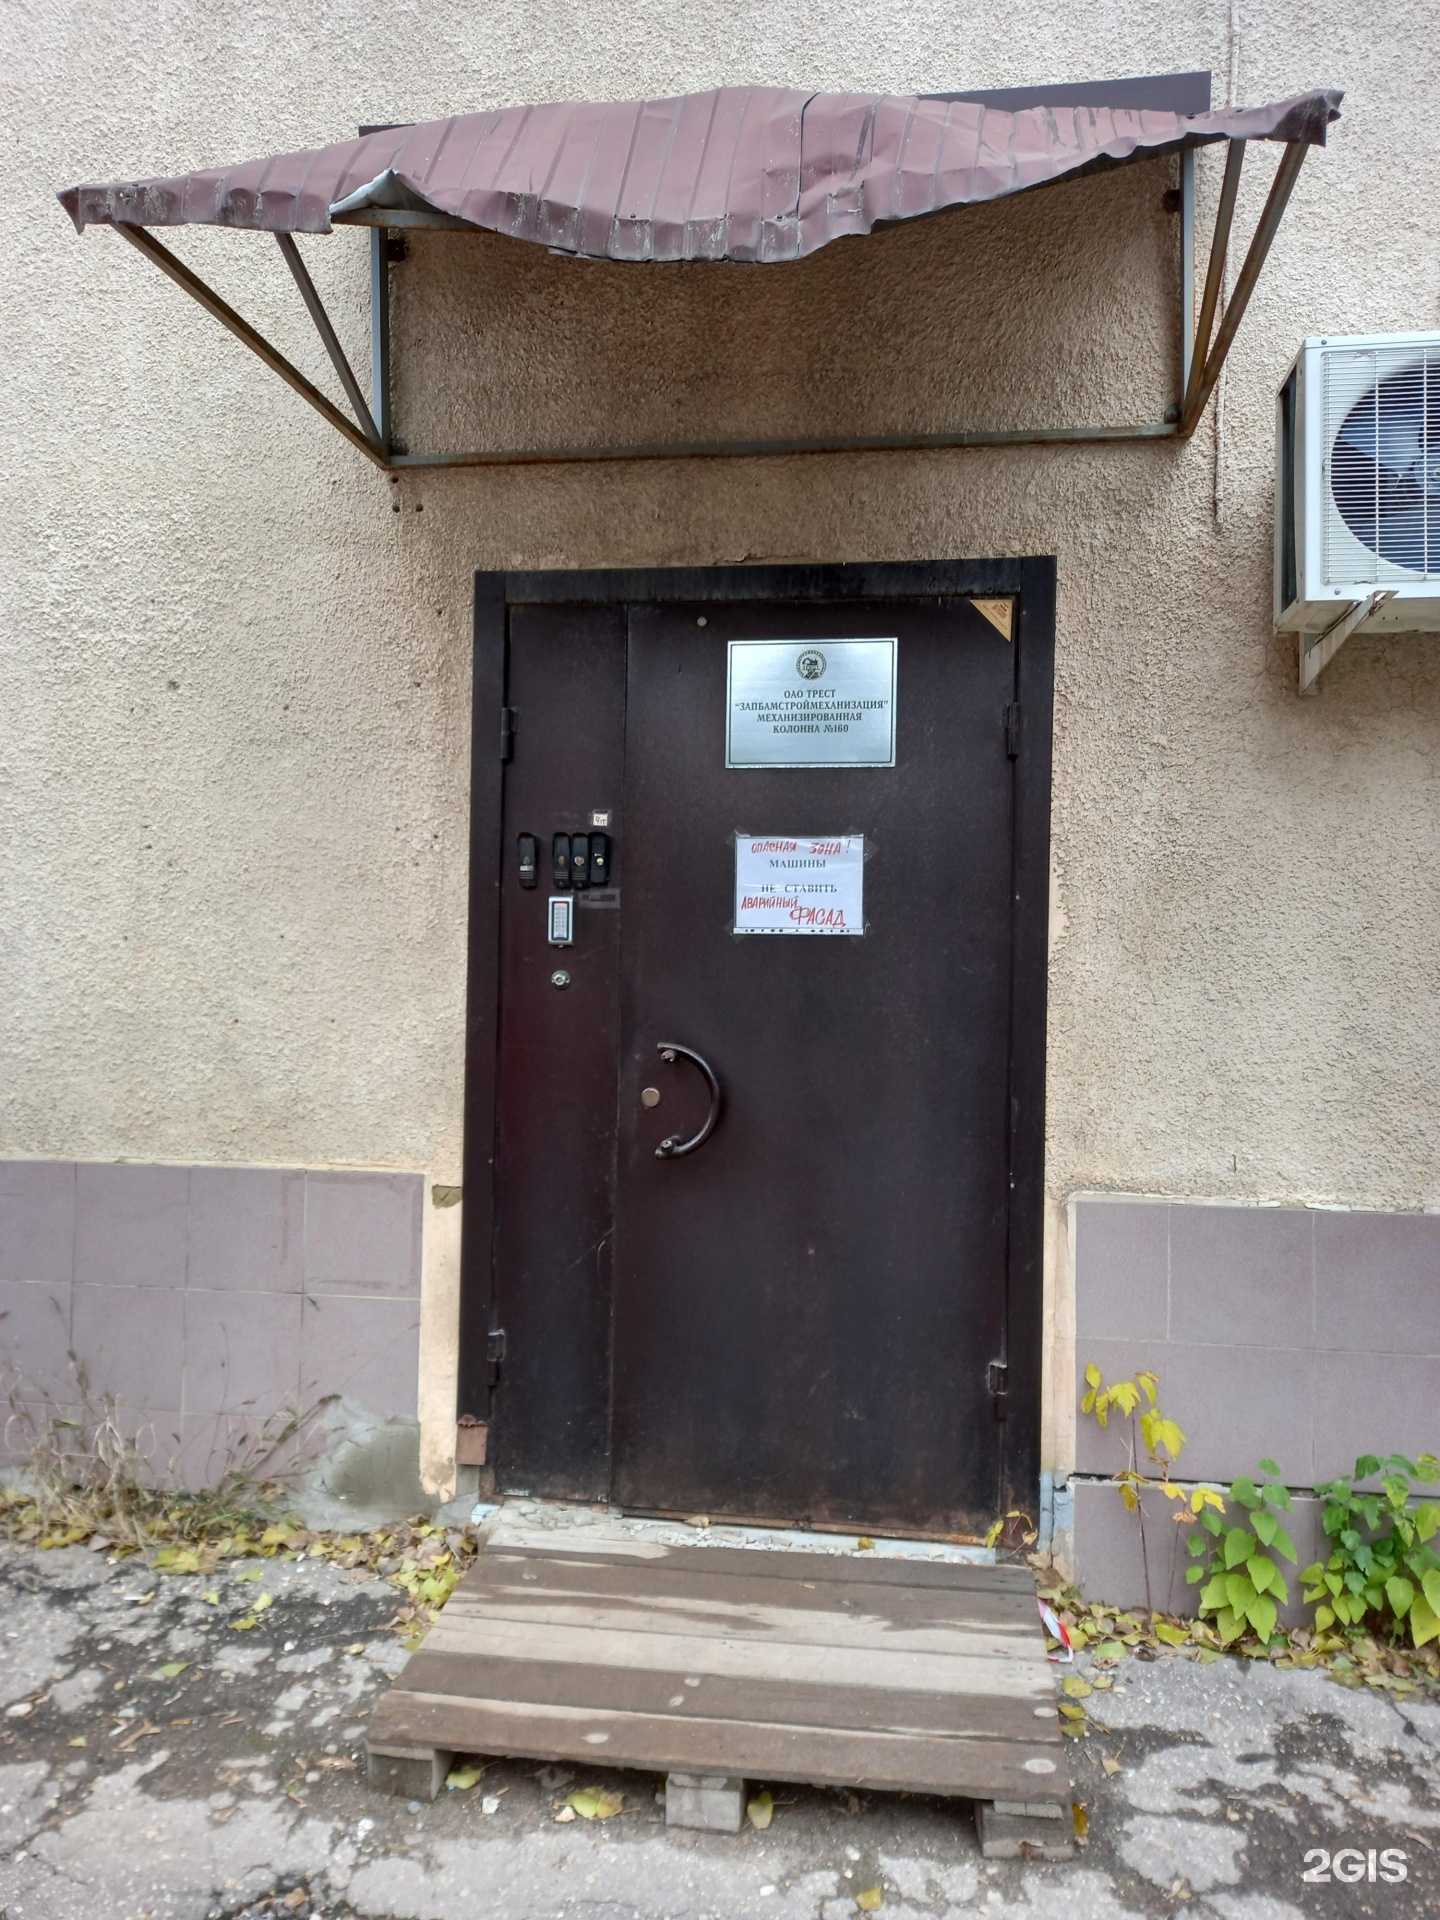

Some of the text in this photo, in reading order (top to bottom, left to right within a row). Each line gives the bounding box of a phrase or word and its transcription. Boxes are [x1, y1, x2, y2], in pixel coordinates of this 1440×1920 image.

[784, 689, 836, 699] ОАО ТРЕСТ
[757, 712, 862, 722] МЕХАНИЗИРОВАННАЯ
[773, 724, 849, 734] КОЛОННА №160
[751, 840, 797, 854] ОПАСНАЯ
[769, 859, 826, 868] МАШИНЫ
[761, 883, 838, 893] НЕ СТАВИТЬ
[741, 895, 800, 910] АВАРИЙНЫЙ
[789, 906, 846, 928] ФАСАД
